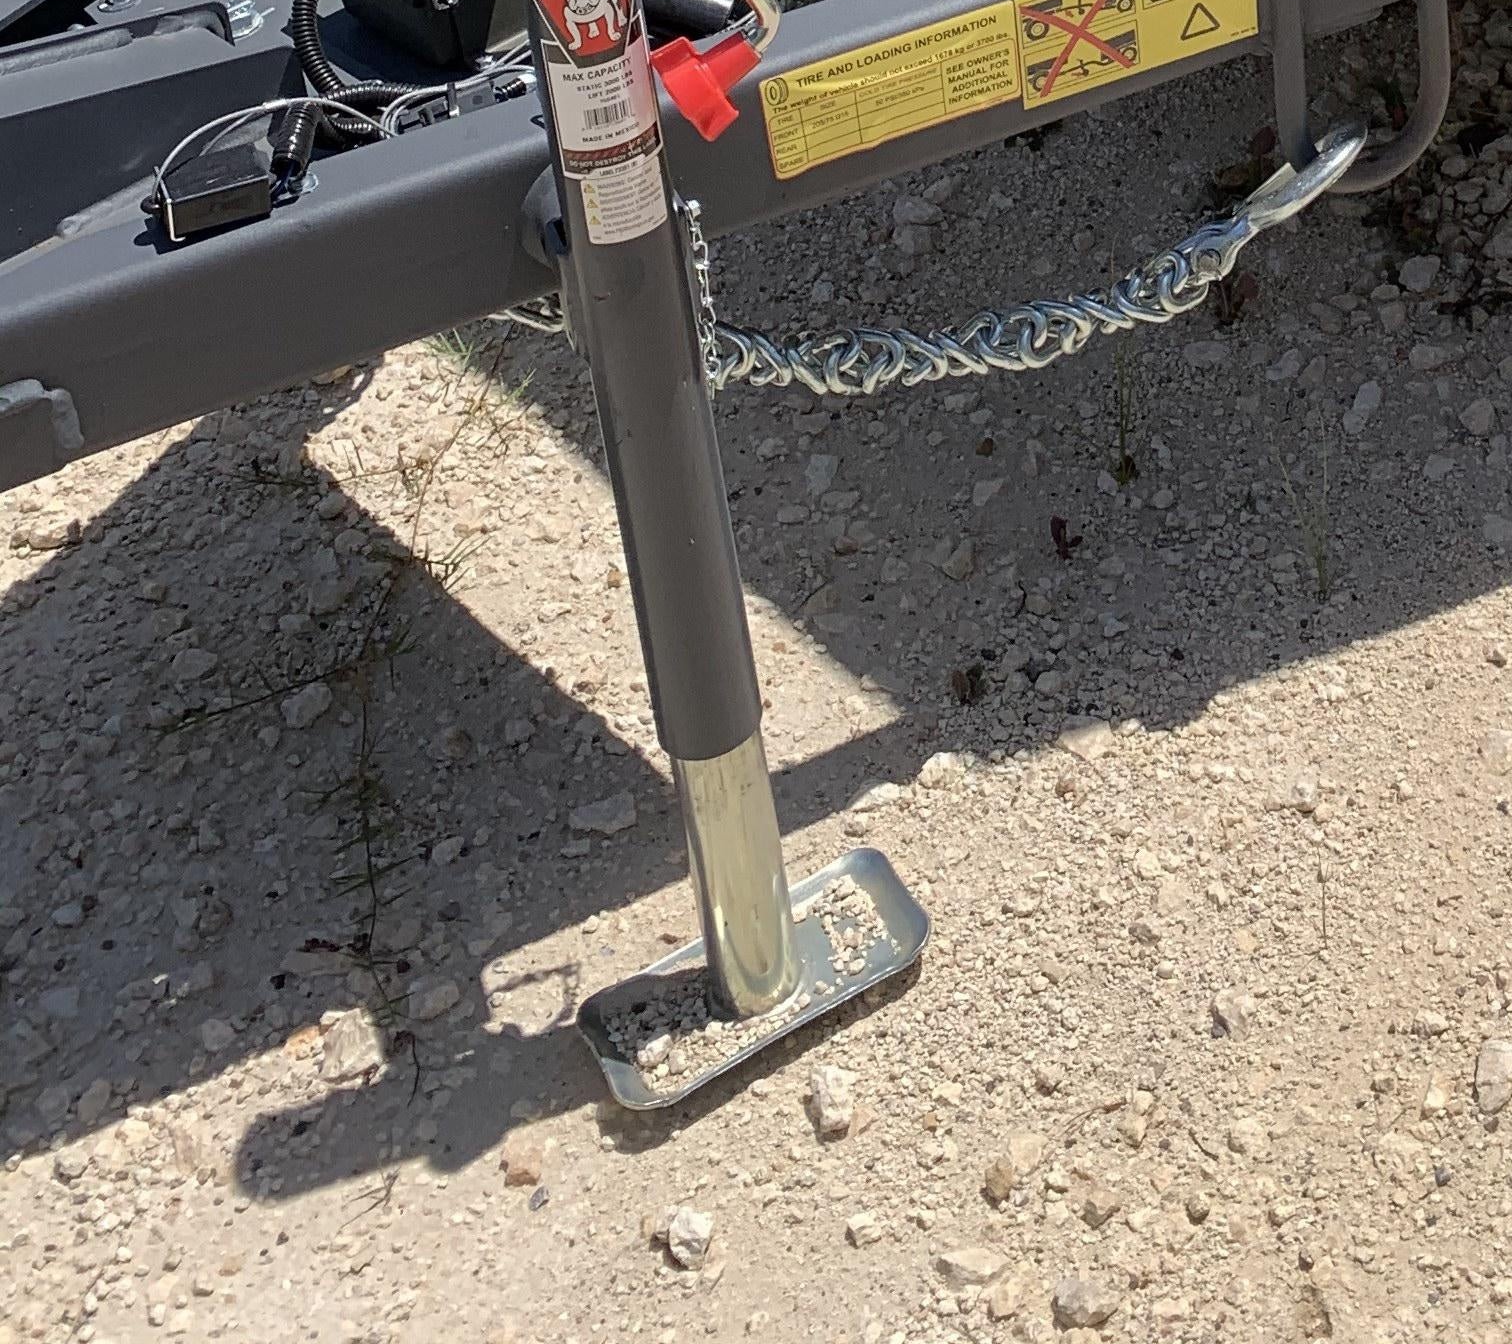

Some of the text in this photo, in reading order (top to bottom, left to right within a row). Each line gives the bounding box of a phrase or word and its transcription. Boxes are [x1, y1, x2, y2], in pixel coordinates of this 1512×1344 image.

[796, 15, 997, 87] TIRE AND LOADING INFORMATION
[946, 48, 1010, 75] SEE OWNER'S
[587, 57, 631, 79] CAPACITY
[948, 59, 1009, 84] MANUAL FOR
[773, 105, 788, 114] The
[790, 95, 817, 108] weight
[819, 90, 828, 99] of
[830, 83, 859, 96] vehicle
[860, 71, 887, 86] should
[888, 67, 903, 77] not
[904, 57, 932, 71] exceed
[948, 79, 1013, 105] INFORMATION
[952, 71, 1008, 93] ADDITIONAL
[774, 128, 799, 141] FRONT
